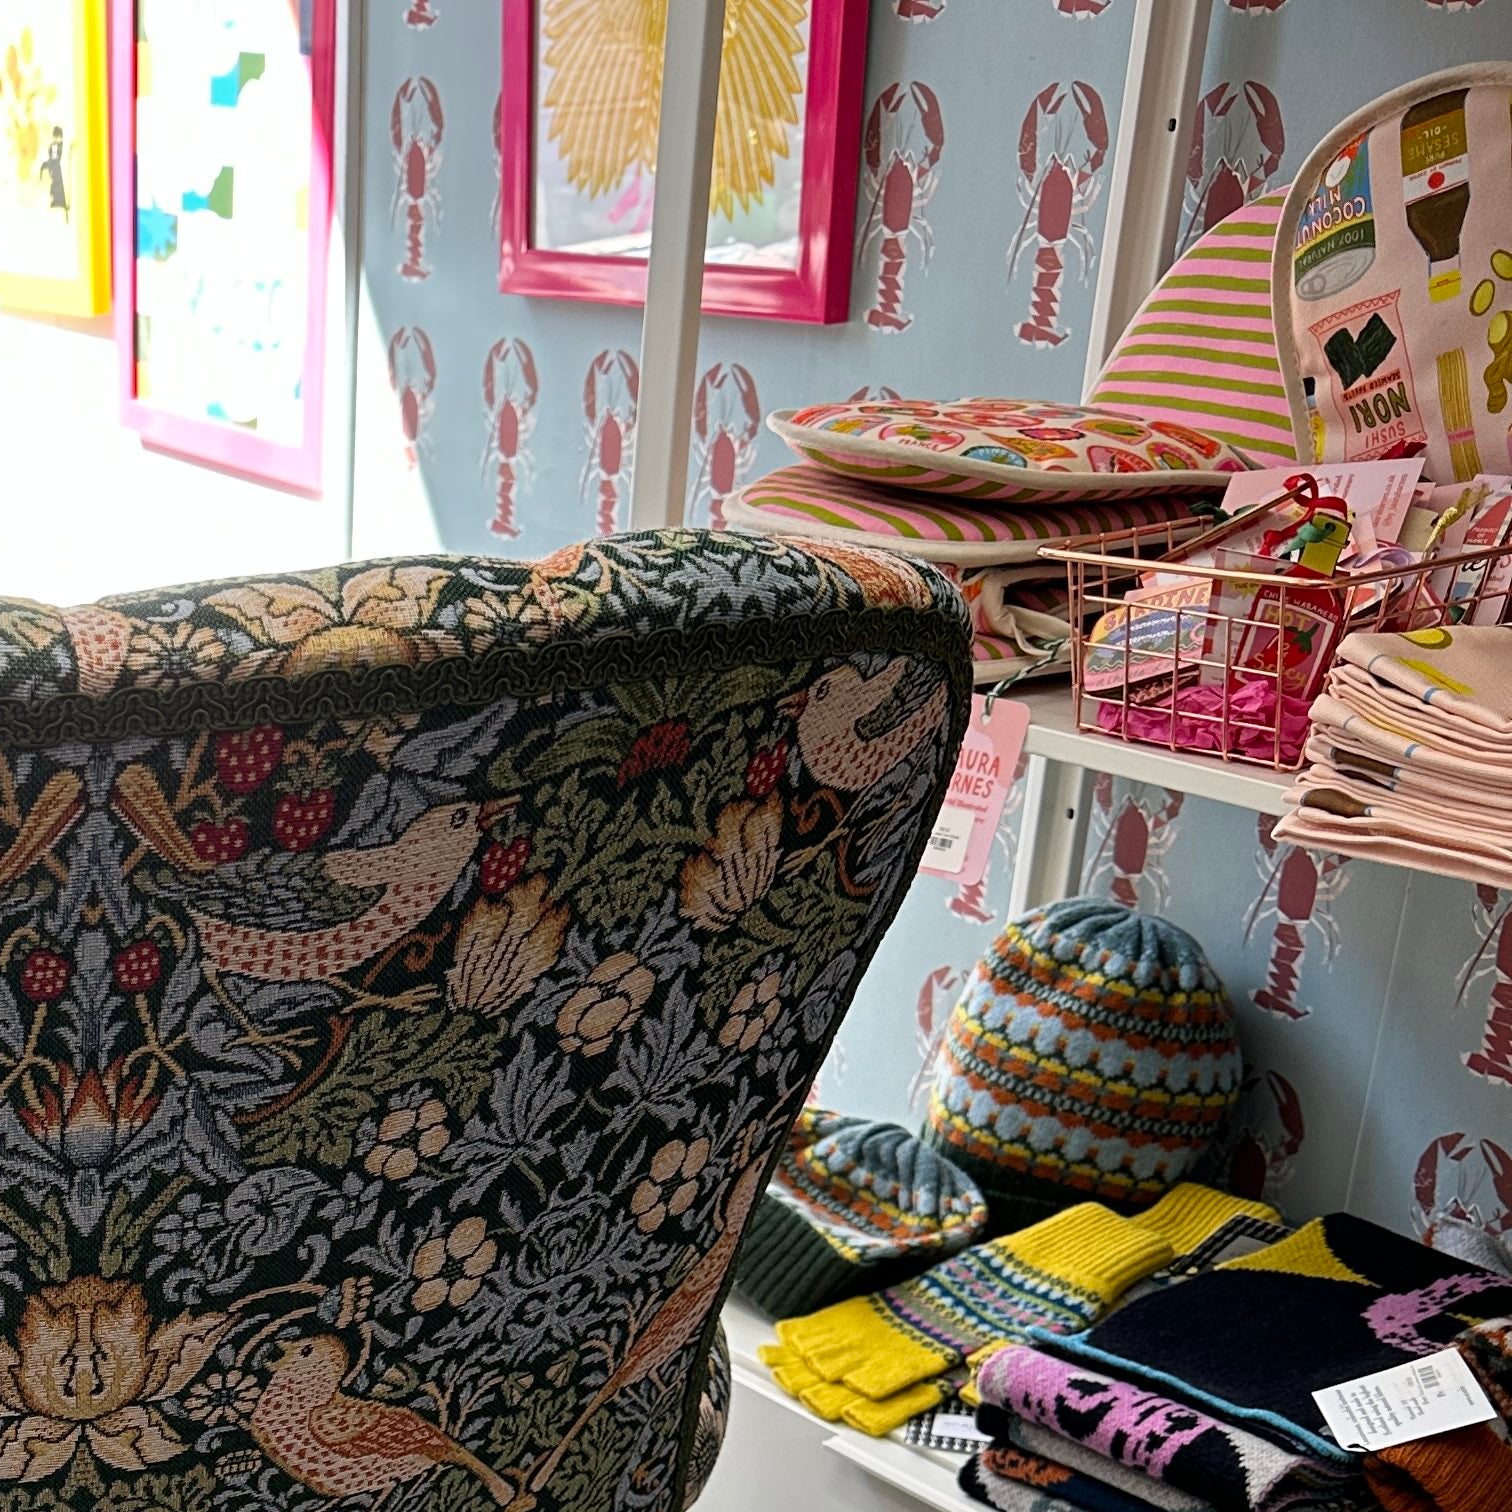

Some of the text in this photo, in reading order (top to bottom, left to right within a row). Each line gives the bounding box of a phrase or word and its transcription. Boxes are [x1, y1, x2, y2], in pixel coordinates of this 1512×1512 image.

[1408, 131, 1460, 161] SESAME
[1308, 186, 1341, 216] MILK
[1296, 196, 1366, 249] COCONUT
[1349, 381, 1411, 433] NORI
[1365, 421, 1406, 449] SUSHI
[1263, 590, 1290, 604] CHIE
[1265, 606, 1312, 631] HOT
[1253, 653, 1308, 692] Spcy
[950, 772, 995, 799] RNES
